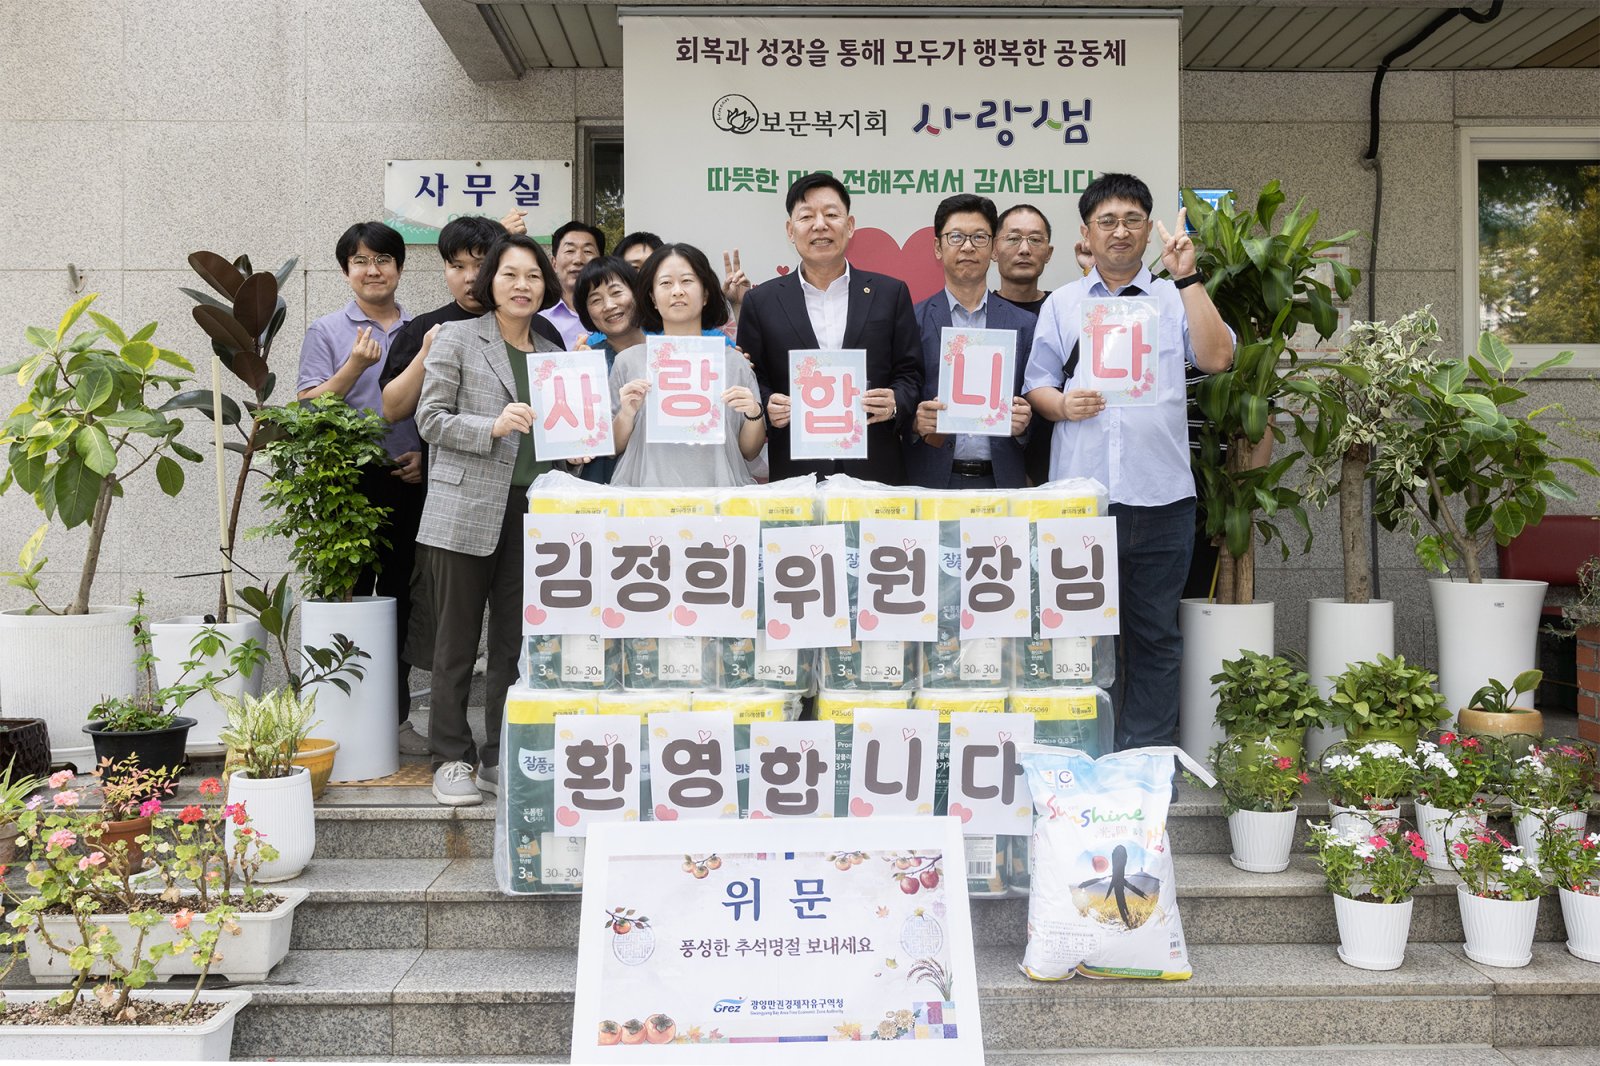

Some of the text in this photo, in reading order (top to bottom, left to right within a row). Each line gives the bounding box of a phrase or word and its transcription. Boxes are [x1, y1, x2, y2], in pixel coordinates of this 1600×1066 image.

[676, 37, 1126, 67] 회복과 성장을 통해 모두가 행복한 공동체
[760, 109, 887, 138] 보문복지회
[912, 98, 1091, 147] 사랑샘
[415, 172, 541, 207] 사무실
[707, 167, 779, 193] 따뜻한
[843, 168, 963, 195] 전해주셔서
[974, 168, 1097, 194] 감사합니다
[679, 935, 875, 958] 풍성한 추석명절 보내세요
